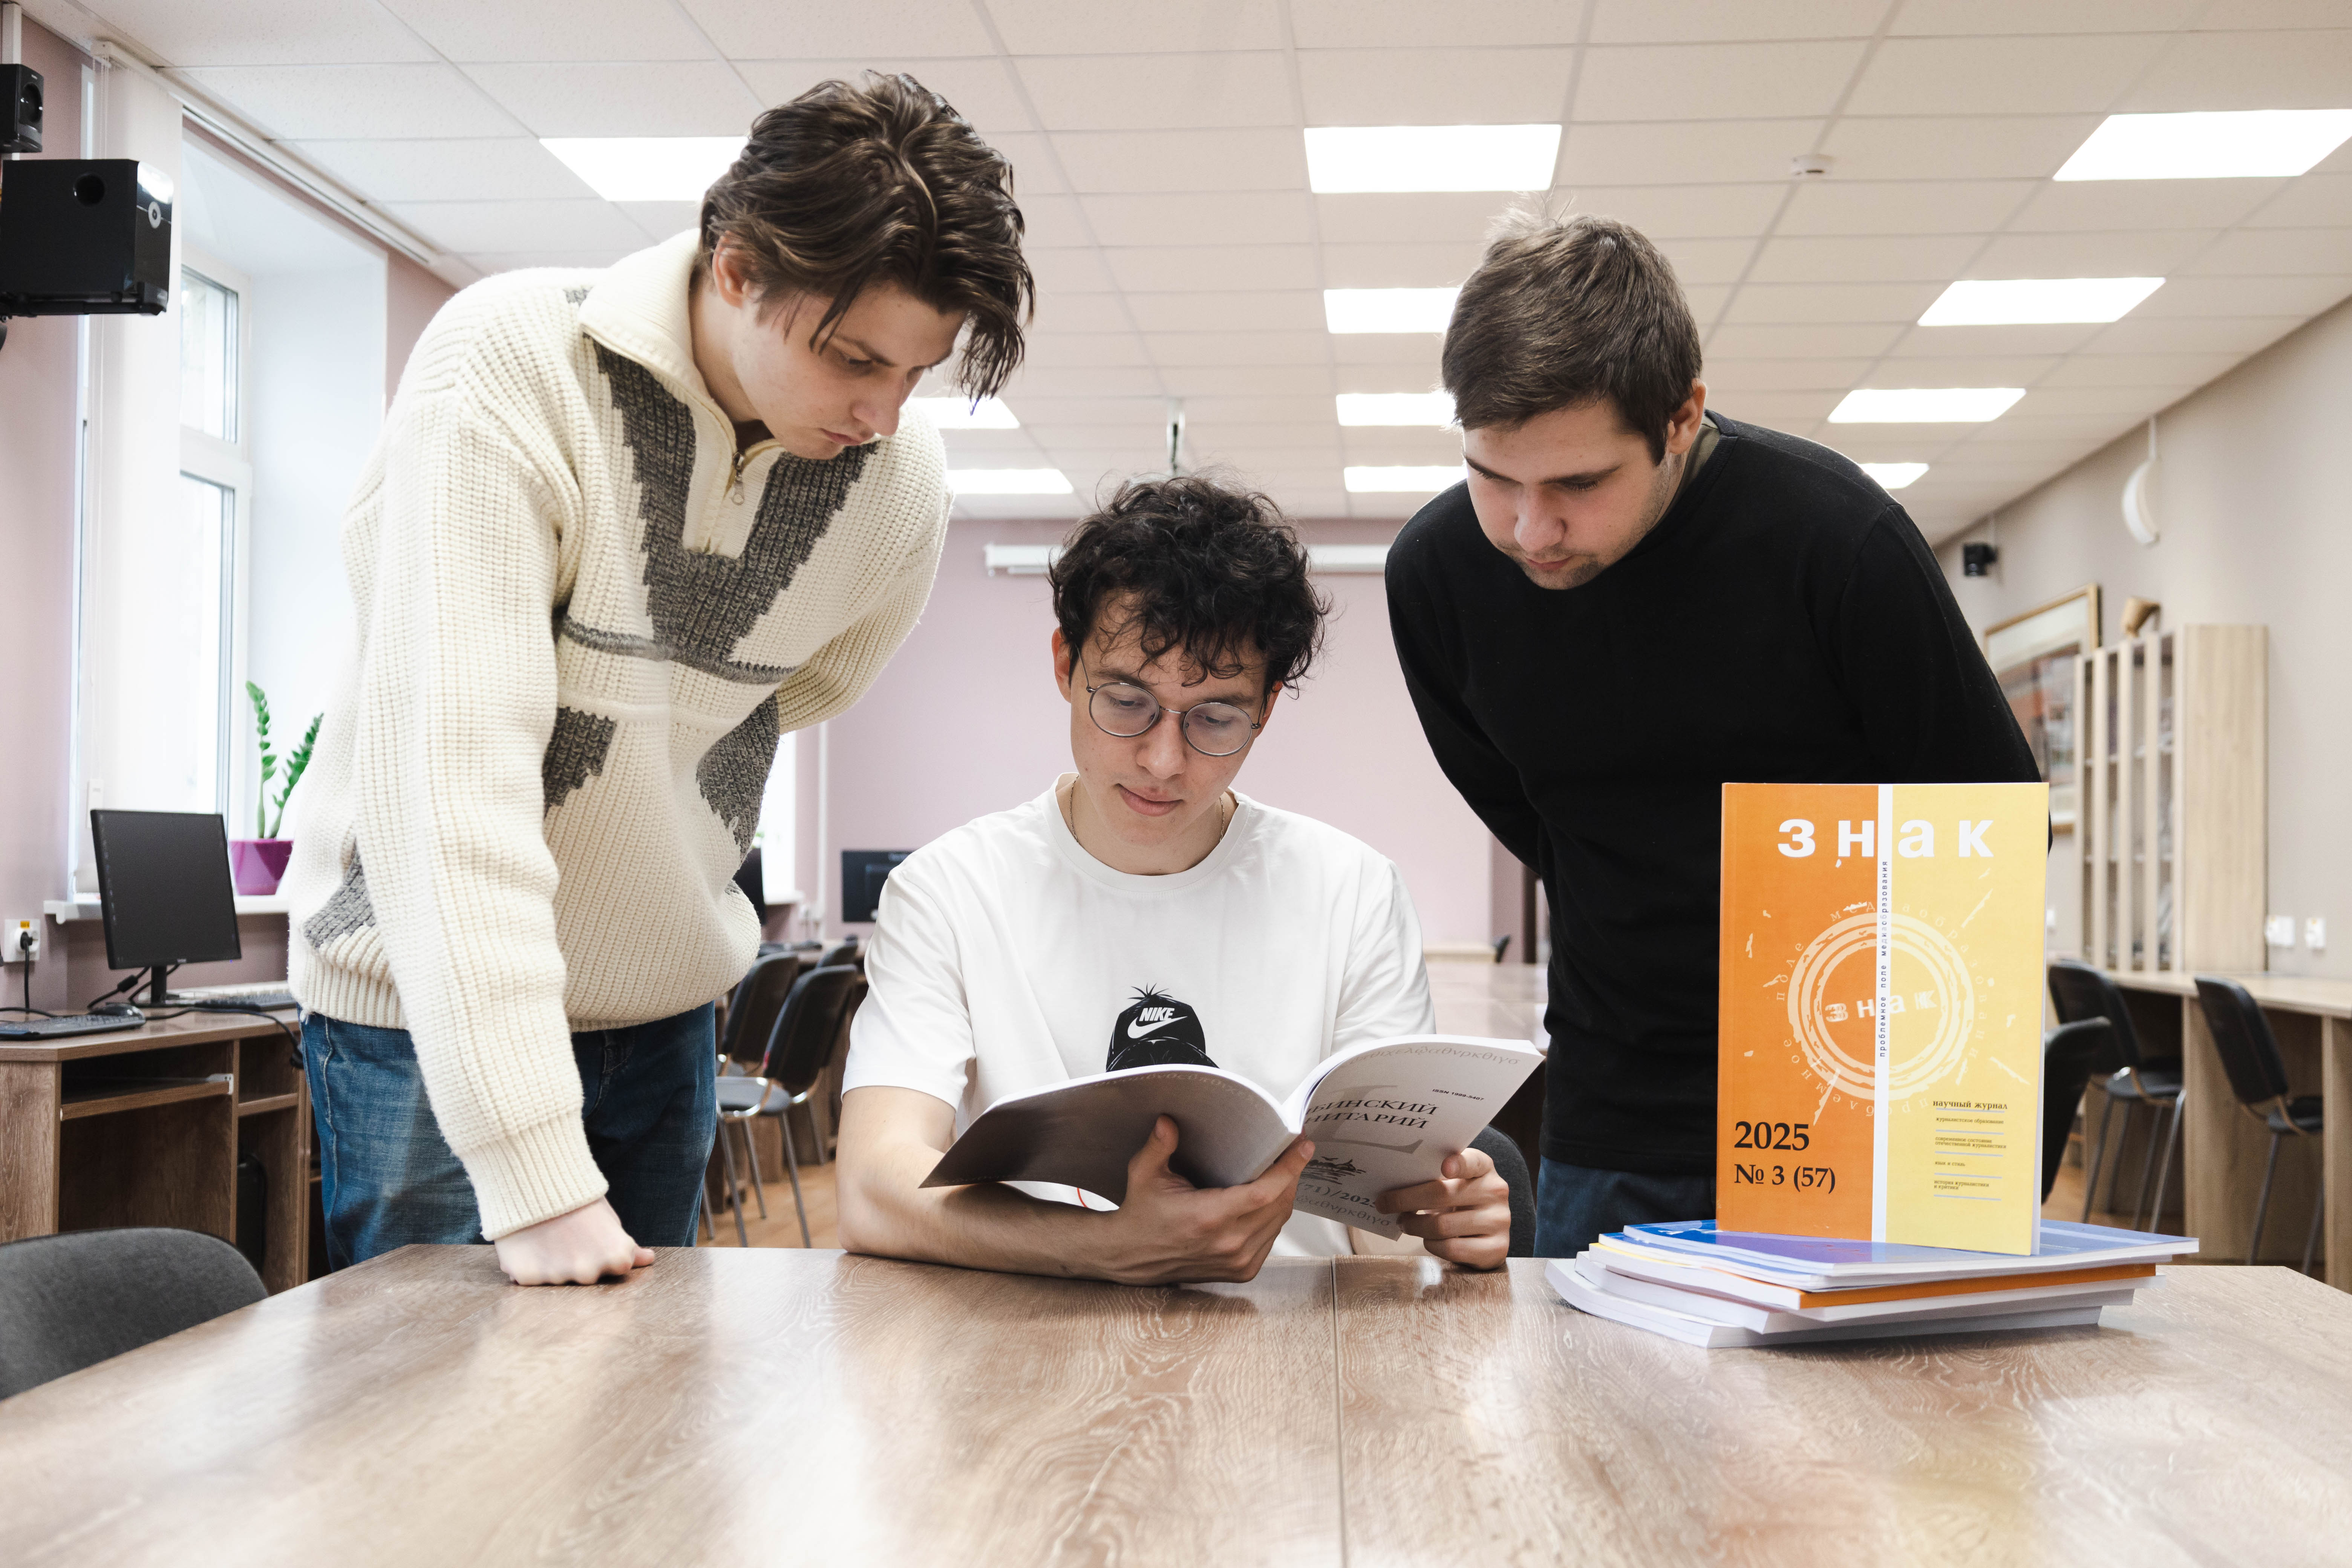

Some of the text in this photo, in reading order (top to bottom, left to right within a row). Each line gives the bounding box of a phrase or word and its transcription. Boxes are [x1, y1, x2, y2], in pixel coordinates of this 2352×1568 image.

[1778, 819, 1994, 858] знак
[1880, 862, 1888, 956] медиаобразования
[1139, 1007, 1175, 1021] NIKE
[1306, 1099, 1439, 1115] БИНСКИЙ
[1452, 1092, 1484, 1101] 1999-5407
[1305, 1112, 1429, 1129] НИТАРИЙ
[1734, 1121, 1809, 1151] 2025
[1734, 1164, 1835, 1194] № 3 (57)
